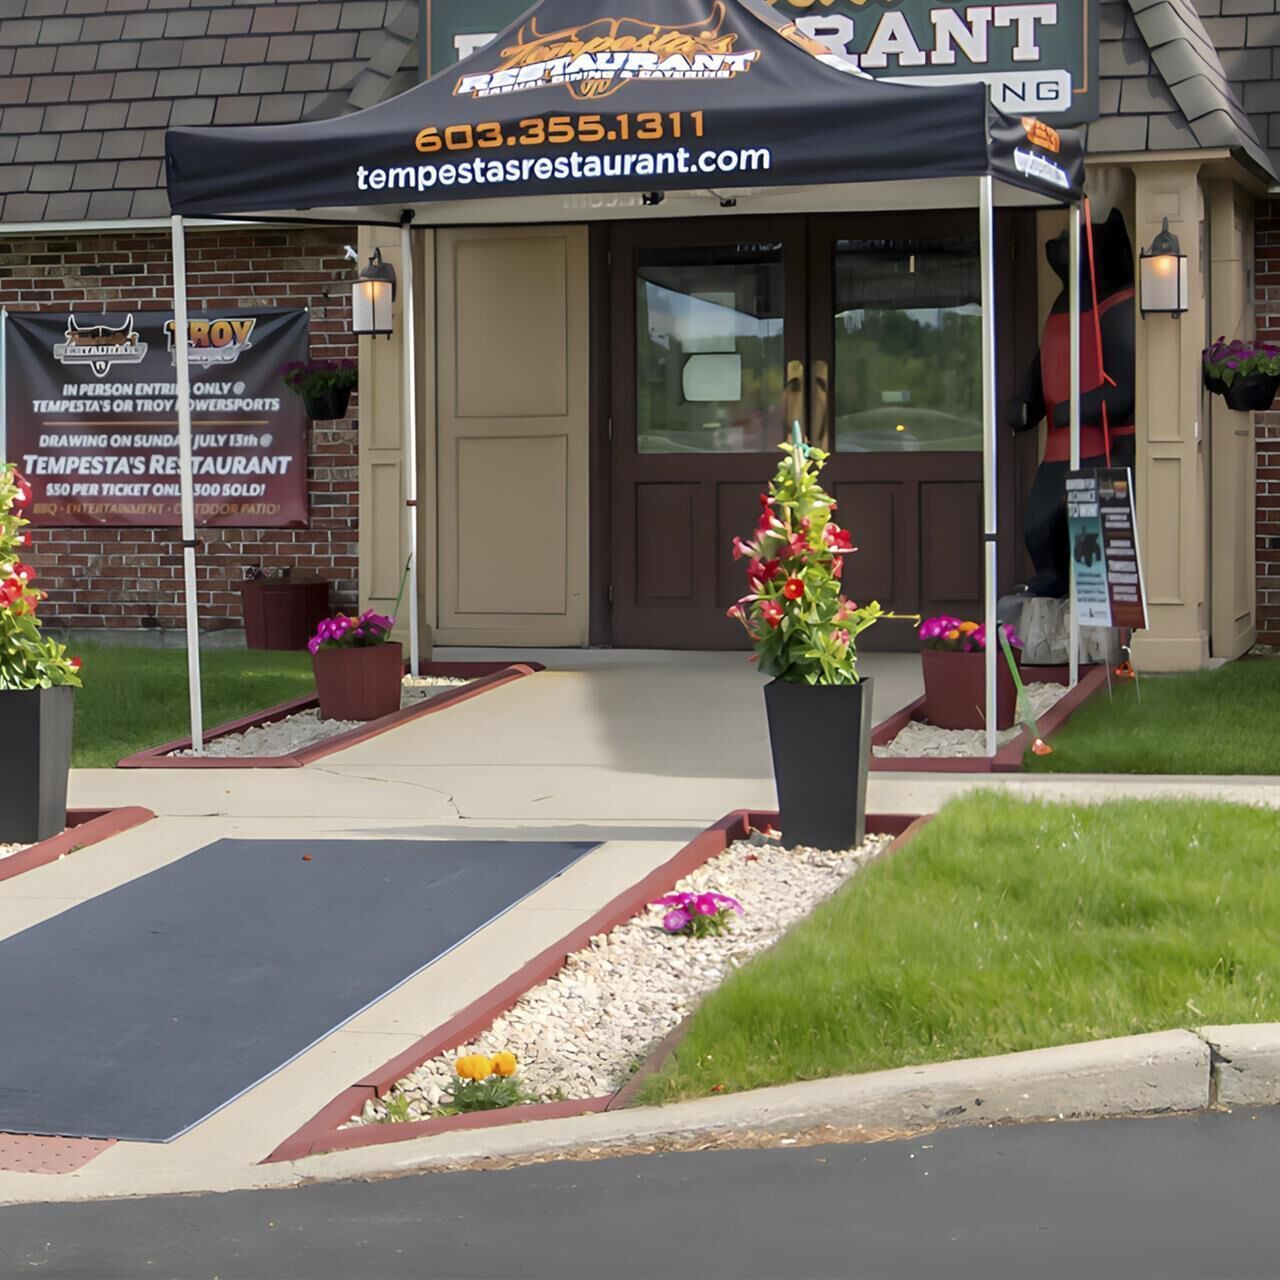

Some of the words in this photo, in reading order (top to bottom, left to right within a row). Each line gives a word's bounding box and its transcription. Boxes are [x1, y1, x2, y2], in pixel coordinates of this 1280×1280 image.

[455, 49, 761, 94] RESTAURANT
[415, 111, 704, 153] 603.355.1311
[356, 147, 771, 191] tempestasrestaurant.com
[169, 320, 253, 349] ROY
[62, 384, 78, 396] IN
[79, 384, 133, 396] PERSON
[135, 383, 182, 396] ENTRI
[193, 382, 232, 395] ONLY
[32, 400, 111, 413] TEMPESTA'S
[112, 400, 133, 412] OR
[136, 399, 174, 411] TROY
[175, 398, 280, 411] OWERSPORTS
[39, 434, 108, 448] DRAWING
[110, 434, 132, 447] ON
[133, 434, 191, 447] SUNDA
[193, 433, 227, 450] JULY
[23, 454, 146, 475] TEMPESTA'S
[71, 483, 99, 496] PER
[102, 483, 151, 496] TICKET
[152, 483, 185, 496] ONL
[173, 503, 239, 515] OTDOOR
